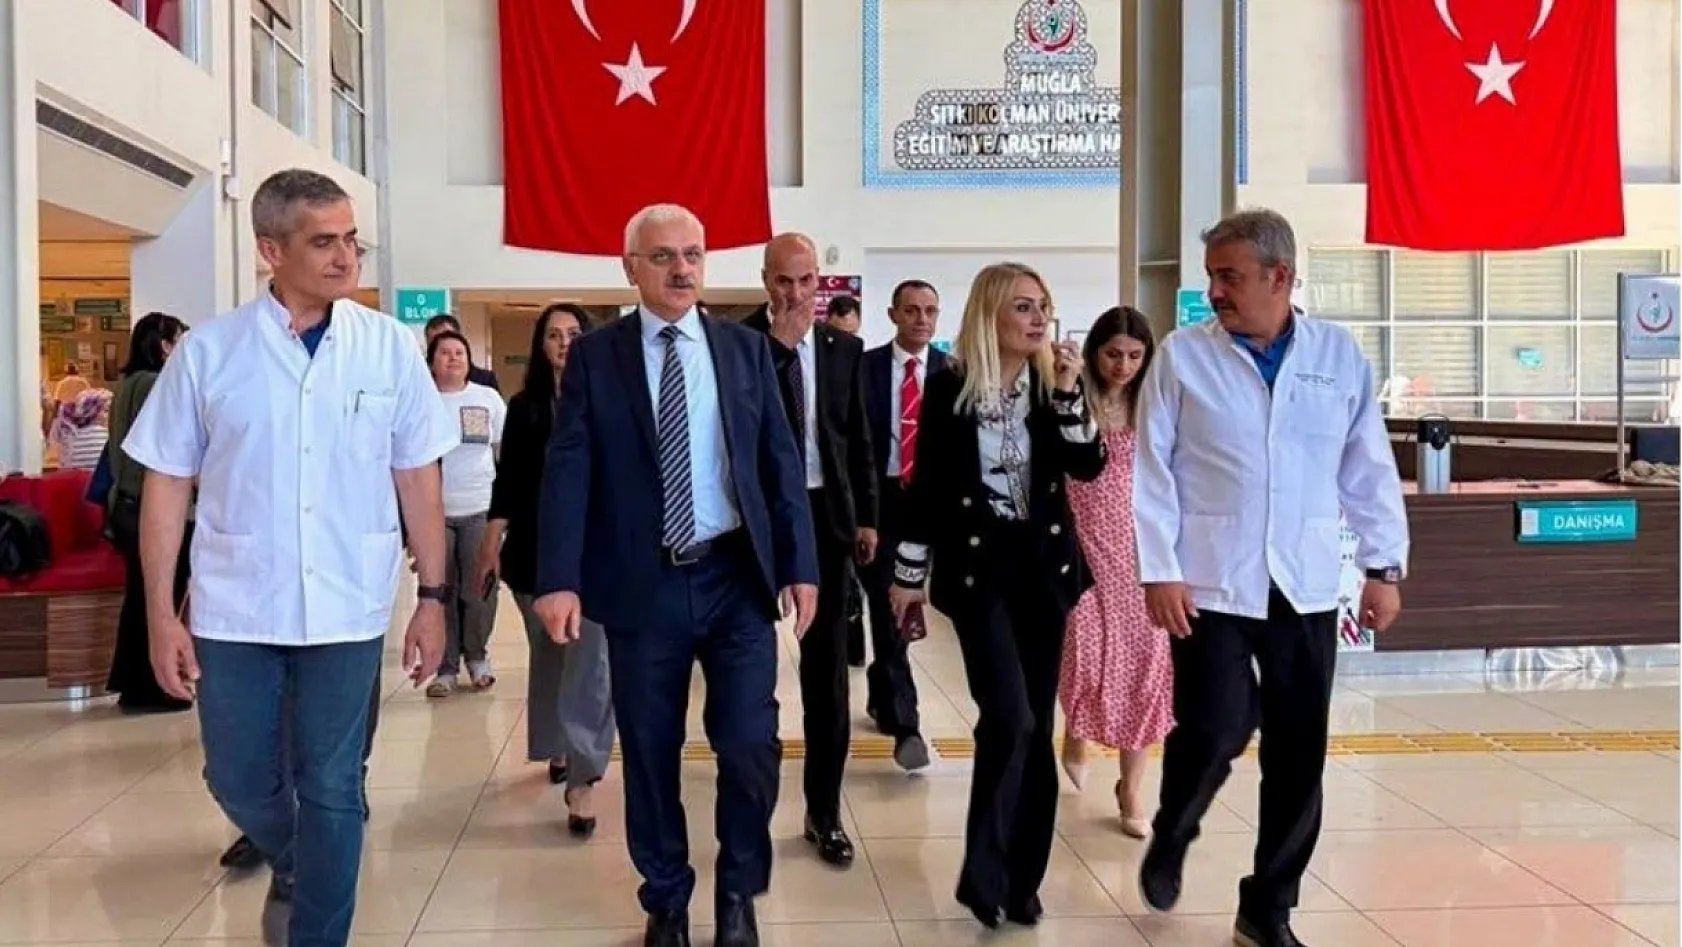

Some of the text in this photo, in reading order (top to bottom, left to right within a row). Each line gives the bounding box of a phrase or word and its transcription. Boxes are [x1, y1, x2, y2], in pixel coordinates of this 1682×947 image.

[1020, 70, 1081, 93] MUĞLA
[930, 104, 973, 124] SITKI
[976, 104, 1048, 126] KOÇMAN
[908, 132, 968, 155] EĞİTİM
[971, 133, 995, 155] VE
[996, 133, 1095, 158] ARAŞTIRMA
[1553, 514, 1625, 531] DANIŞMA
